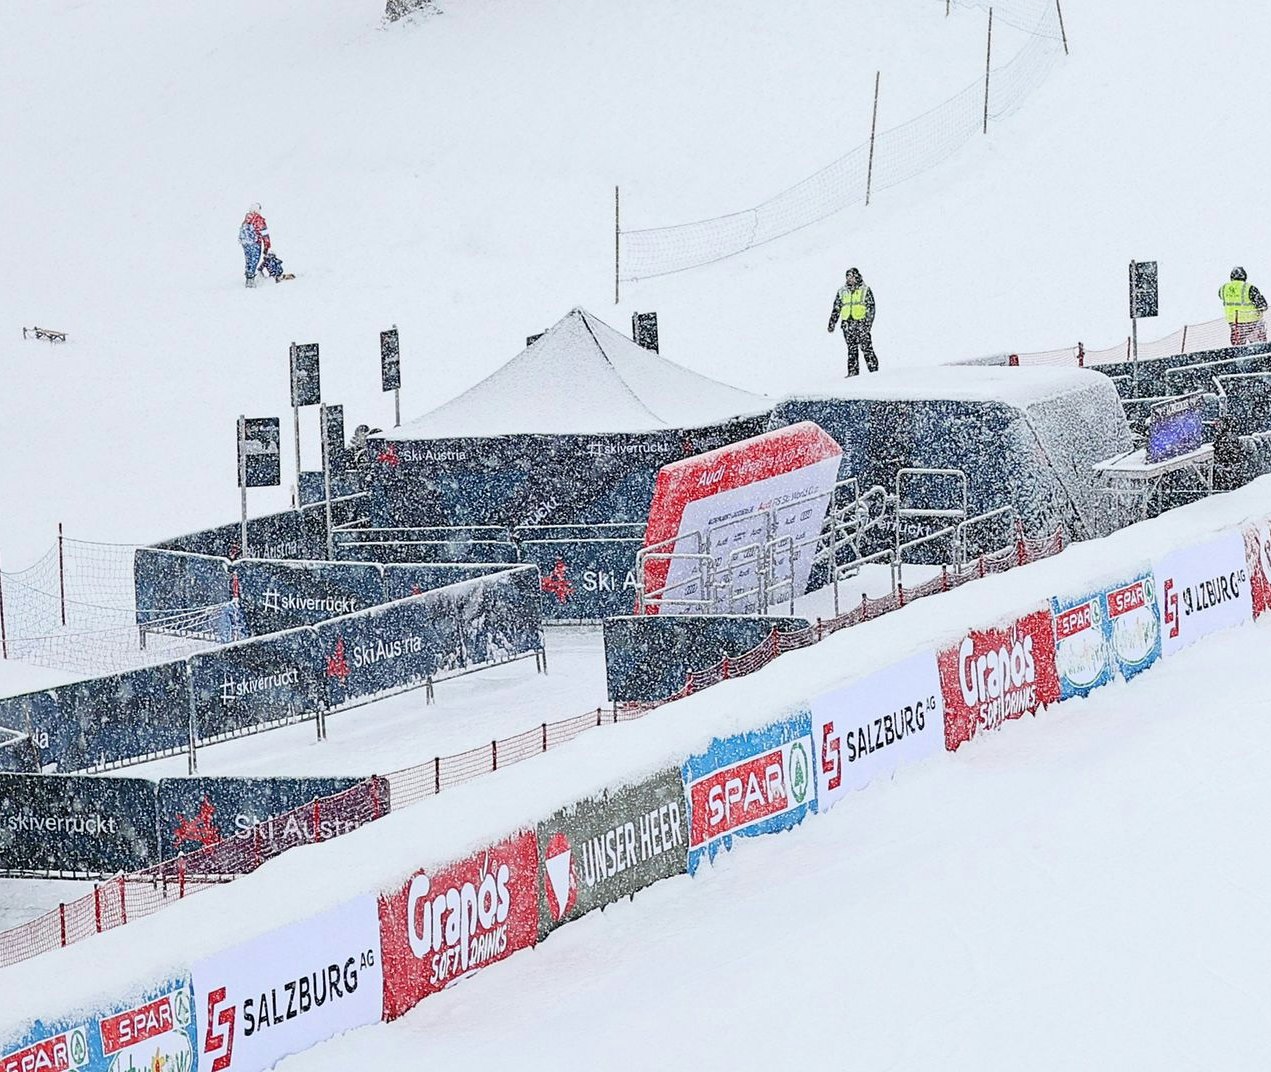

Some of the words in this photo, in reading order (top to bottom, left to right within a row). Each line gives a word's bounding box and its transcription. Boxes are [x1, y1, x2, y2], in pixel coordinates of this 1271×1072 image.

[404, 450, 422, 462] Ski
[424, 449, 466, 462] Austria
[697, 464, 726, 486] Audi
[262, 587, 358, 614] #skiverrückt
[1114, 586, 1144, 612] SPAR
[1061, 609, 1091, 635] SPAR
[352, 641, 376, 670] Ski
[1003, 684, 1037, 721] DRINKS
[846, 709, 927, 765] SALZBURG
[925, 694, 937, 713] AG
[707, 766, 787, 823] SPAR
[580, 830, 640, 888] UNSER
[640, 802, 682, 866] HEER
[429, 948, 464, 985] SOFT
[468, 928, 509, 969] DRINKS
[242, 959, 359, 1038] SALZBURG
[359, 948, 375, 971] AG
[118, 1003, 172, 1044] SPAR
